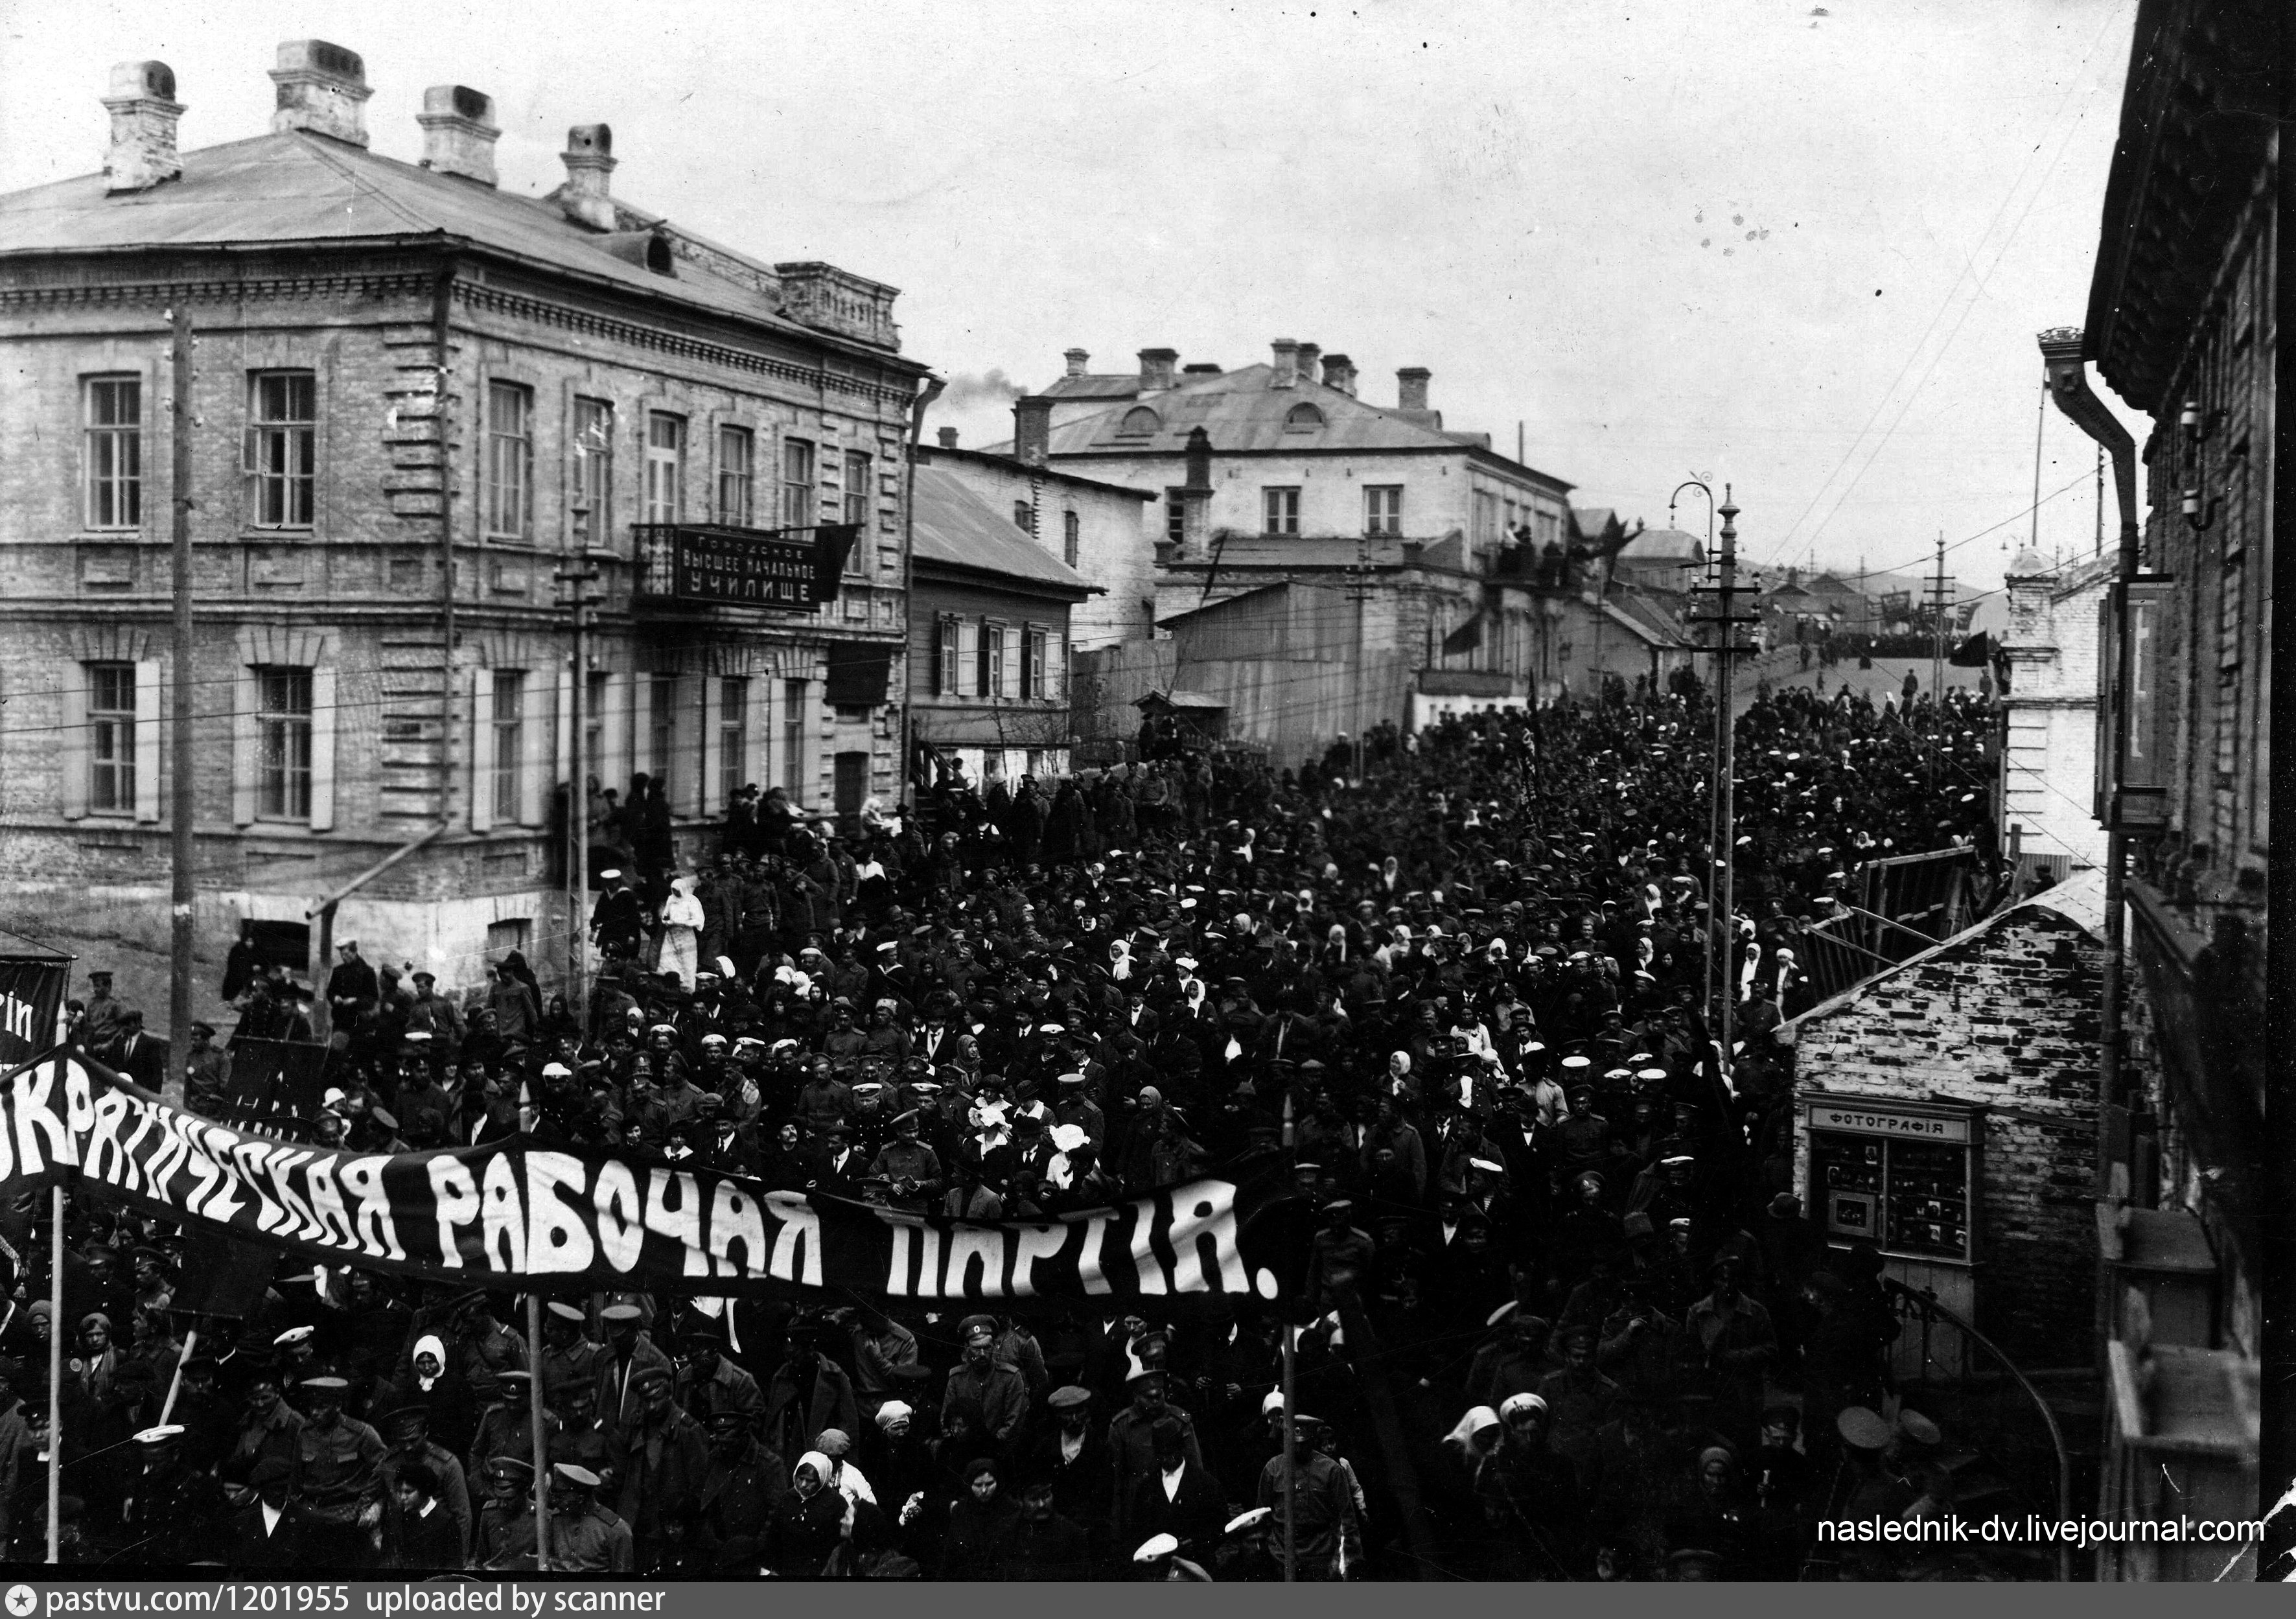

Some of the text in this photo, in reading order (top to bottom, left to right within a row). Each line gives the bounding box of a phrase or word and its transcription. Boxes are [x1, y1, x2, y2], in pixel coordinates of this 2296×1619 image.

[684, 548, 739, 572] ВЫСШЕЕ
[691, 570, 810, 602] УЧИЛИЩЕ
[0, 1059, 406, 1260] КРАТИЧЕСКАЯ
[427, 1152, 822, 1286] РАБОЧАЯ
